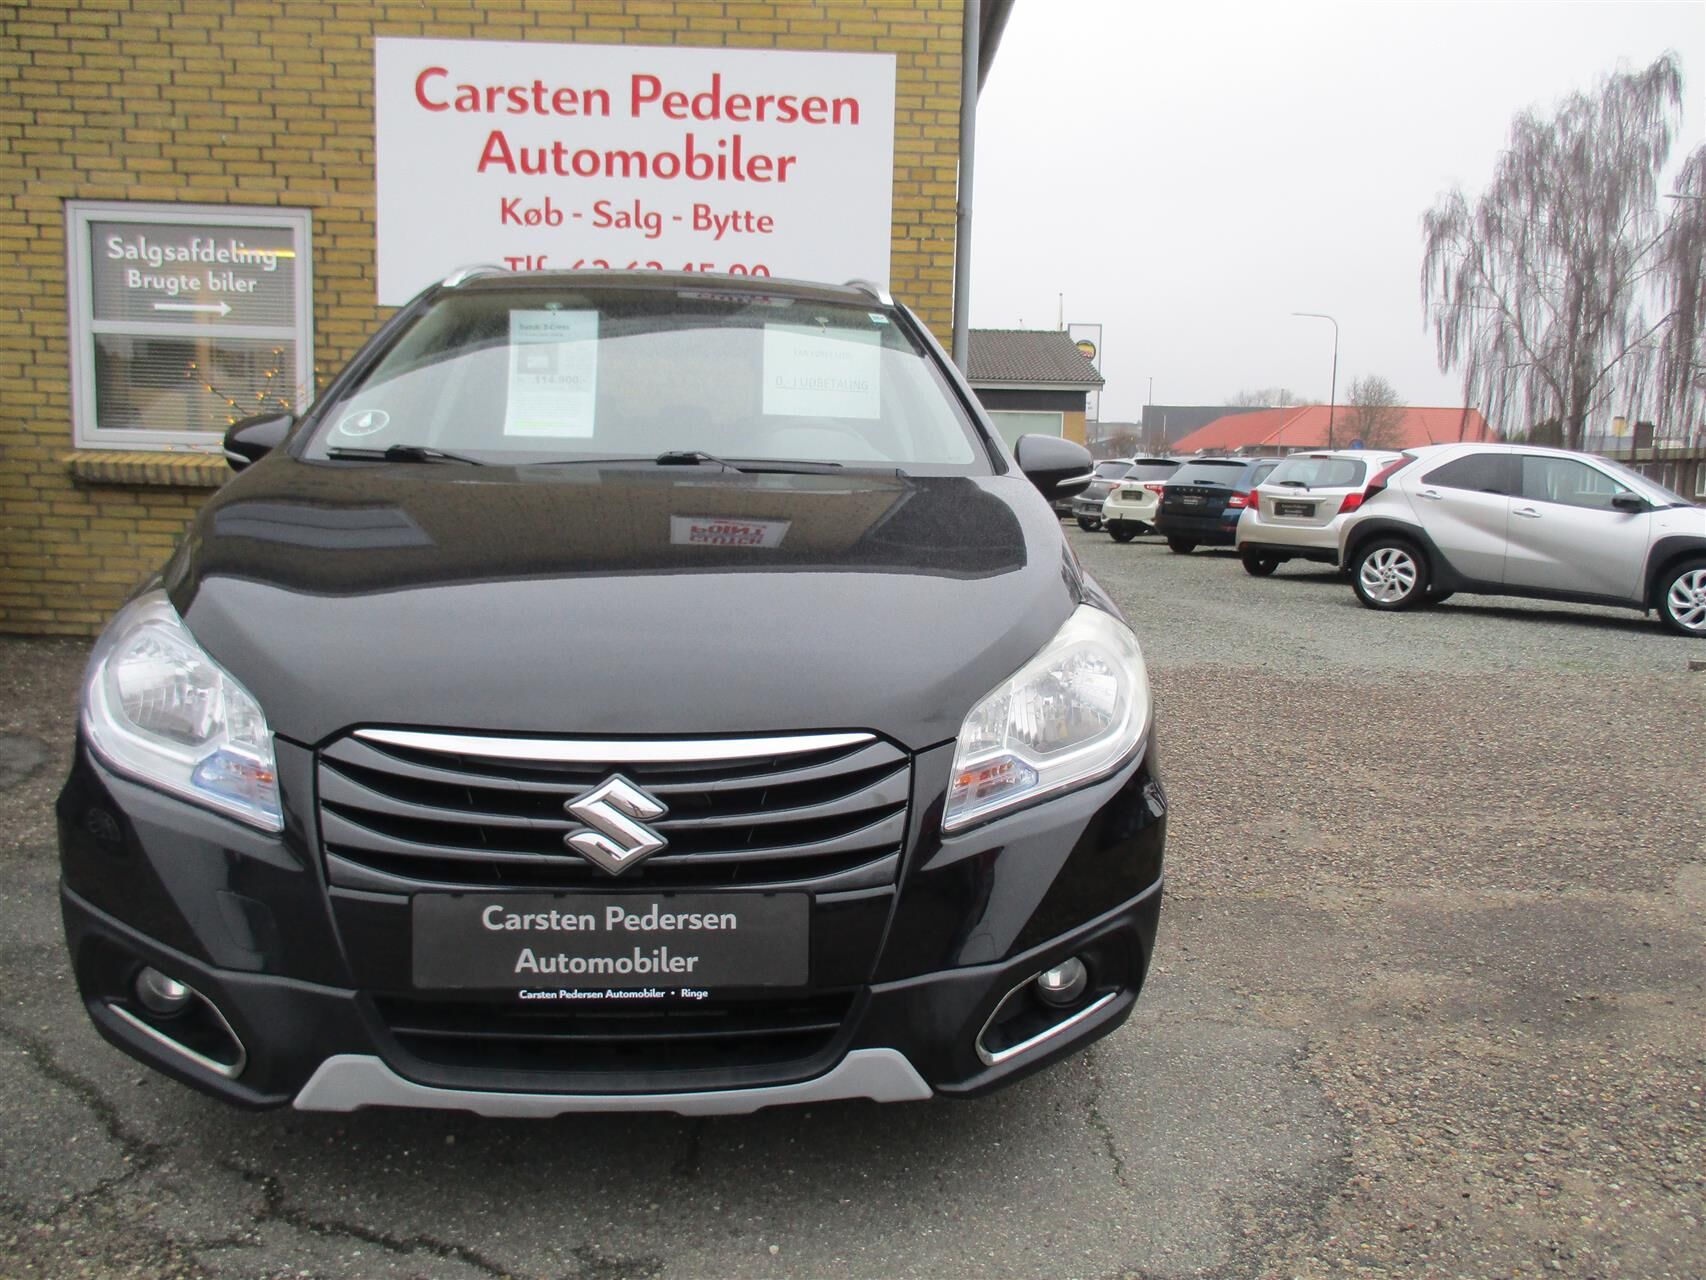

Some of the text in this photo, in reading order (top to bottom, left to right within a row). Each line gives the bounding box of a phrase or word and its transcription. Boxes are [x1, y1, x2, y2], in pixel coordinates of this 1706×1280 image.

[415, 66, 860, 125] Carsten Pedersen
[477, 130, 797, 182] Automobiler
[501, 196, 564, 228] Køb
[592, 199, 663, 240] Salg
[692, 202, 775, 241] Bytte
[107, 235, 277, 272] Salgsafdeling
[127, 268, 258, 296] Brugte biler
[482, 903, 737, 931] Carsten Pedersen
[514, 946, 699, 974] Automobiler
[518, 988, 709, 1000] Carsten Pedersen Automobiler Ringe
